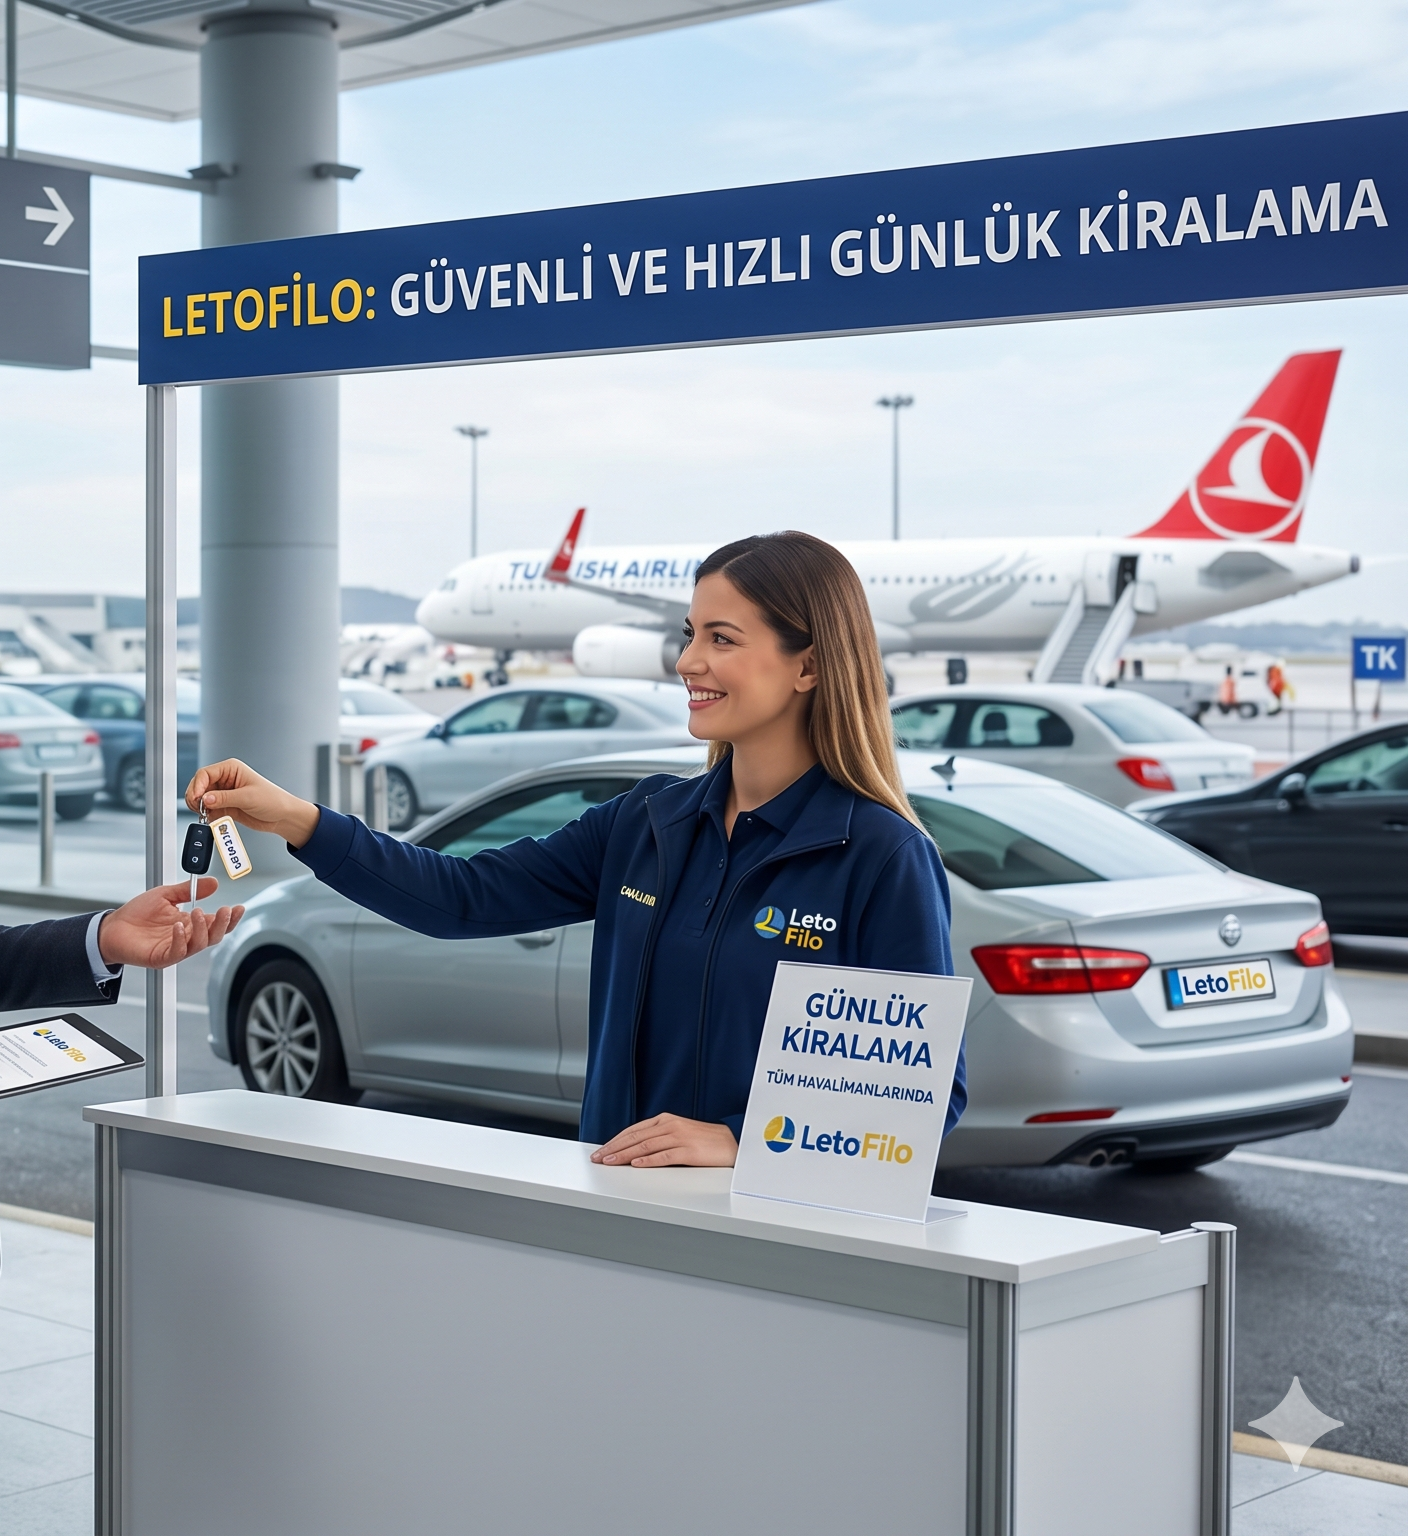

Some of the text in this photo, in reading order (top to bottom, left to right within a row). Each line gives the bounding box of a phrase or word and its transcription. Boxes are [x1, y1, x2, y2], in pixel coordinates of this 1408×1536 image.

[163, 178, 1389, 338] LETOFİLO: GÜVENLİ VE HIZLI GÜNLÜK KİRALAMA
[510, 561, 618, 580] TUISH
[1360, 645, 1398, 670] TK
[789, 908, 837, 932] Leto
[784, 927, 823, 950] Filo
[1182, 968, 1266, 996] LetoFilo
[805, 988, 928, 1030] GÜNLÜK
[781, 1020, 933, 1069] KİRALAMA
[766, 1068, 935, 1104] TÜM HAVALİMANLARINDA
[800, 1125, 913, 1165] LetoFilo
